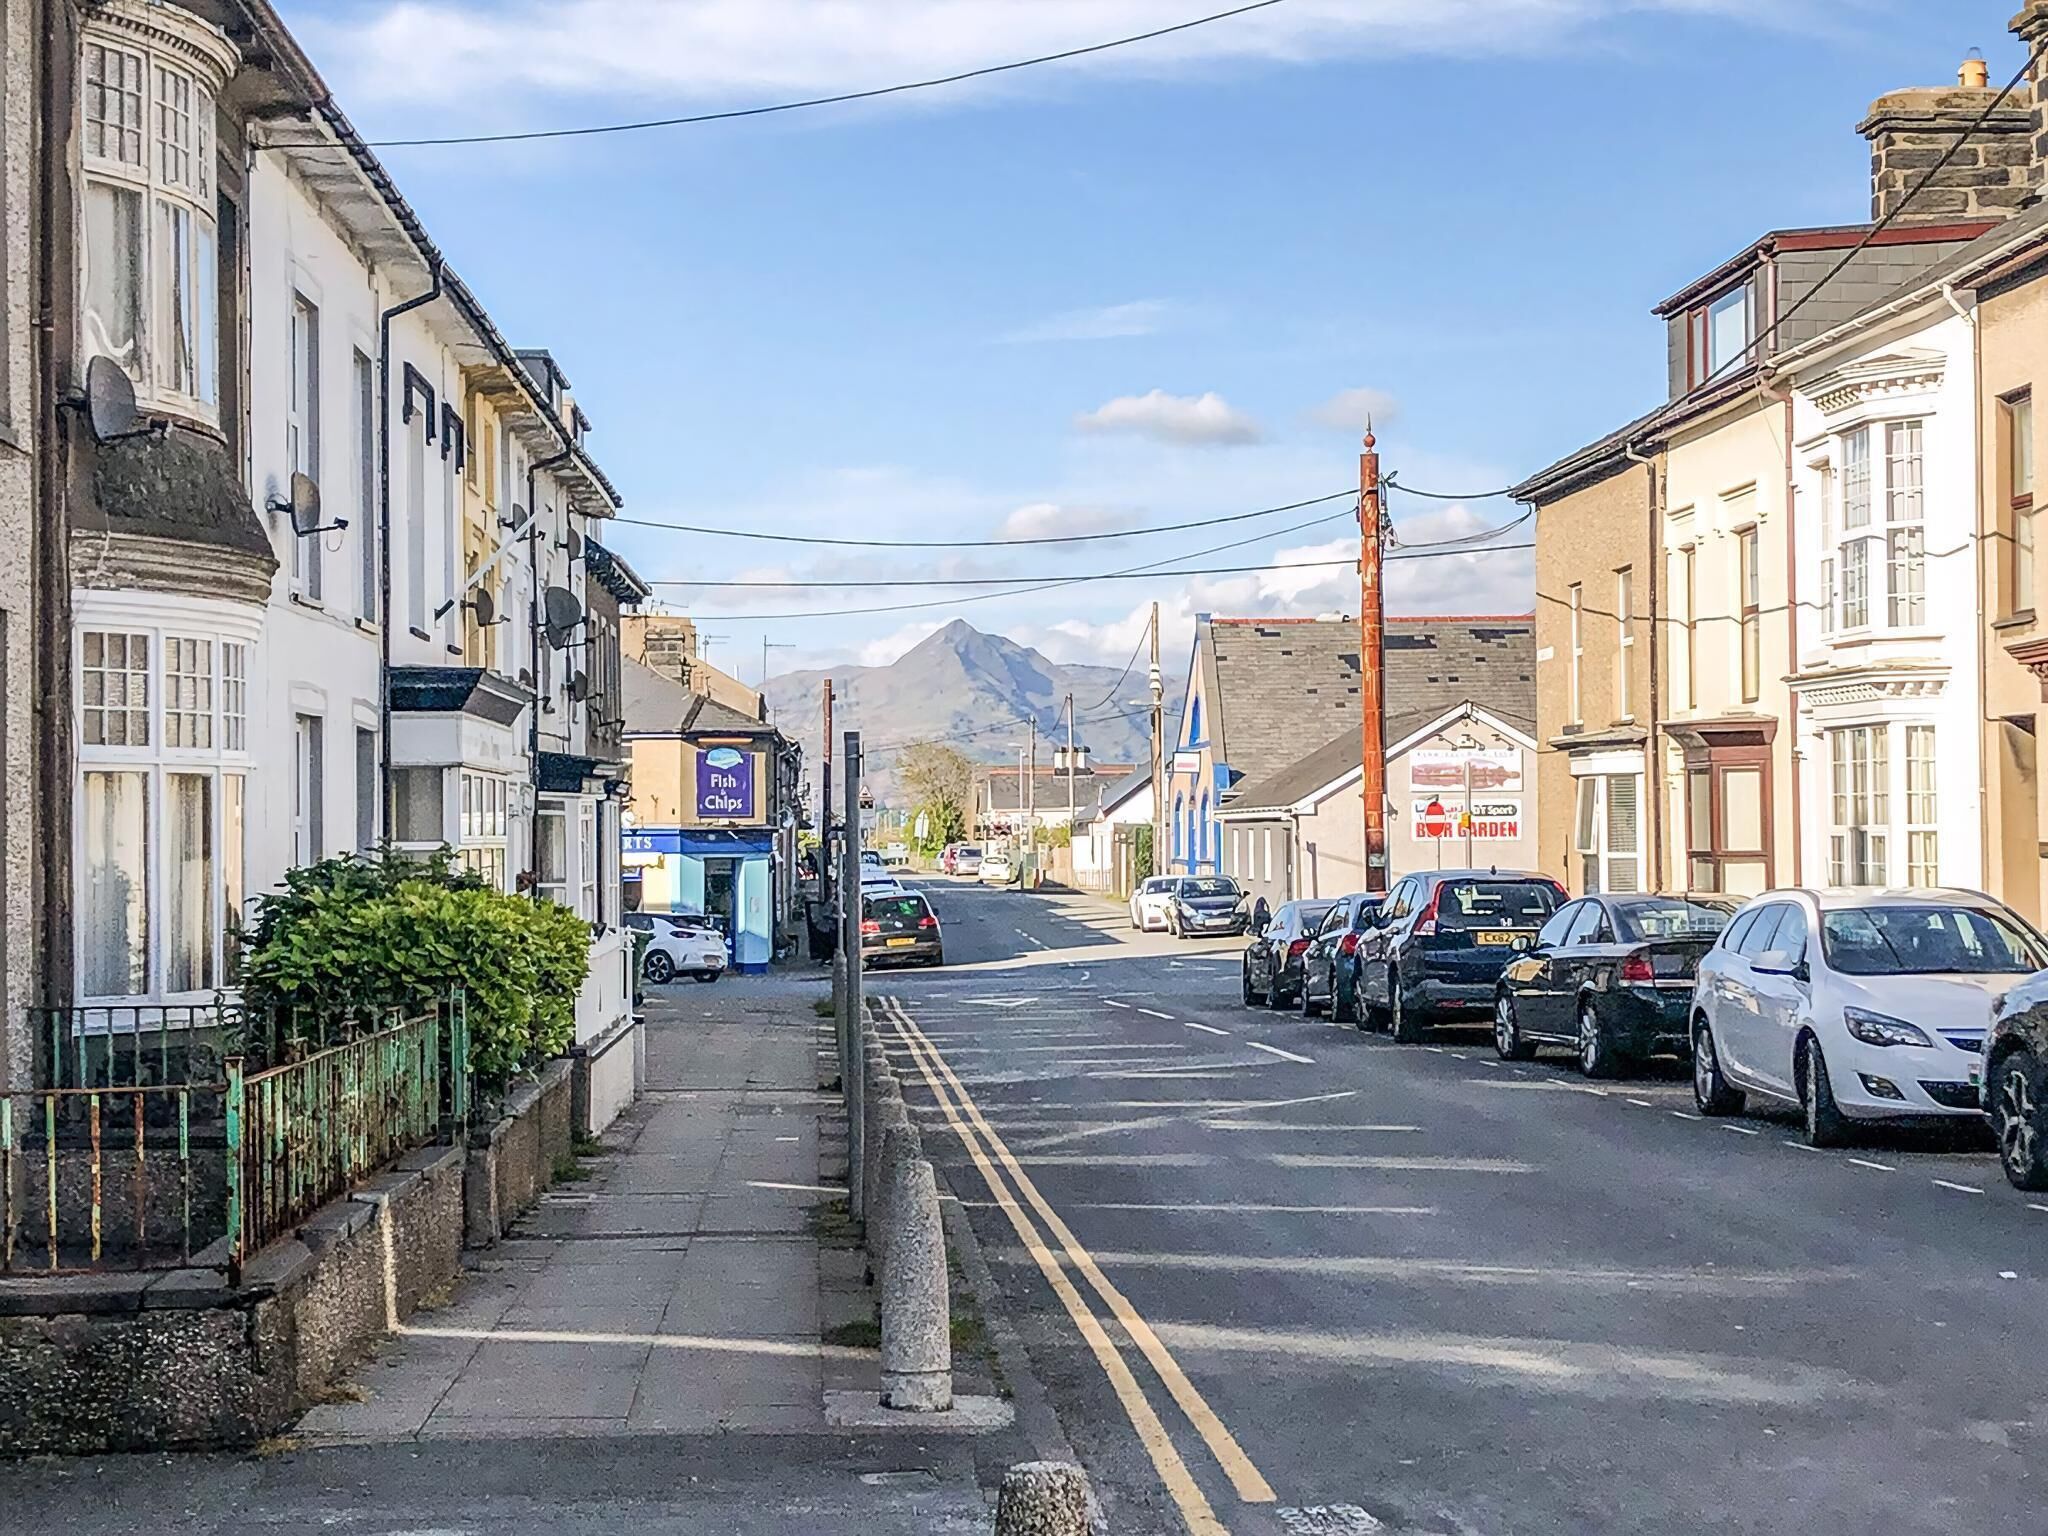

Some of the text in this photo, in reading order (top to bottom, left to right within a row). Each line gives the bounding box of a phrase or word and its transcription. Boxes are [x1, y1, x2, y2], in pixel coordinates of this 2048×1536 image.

[711, 773, 737, 788] Fish
[704, 795, 743, 812] Chips
[1487, 805, 1514, 816] Sport
[1416, 822, 1453, 837] BR
